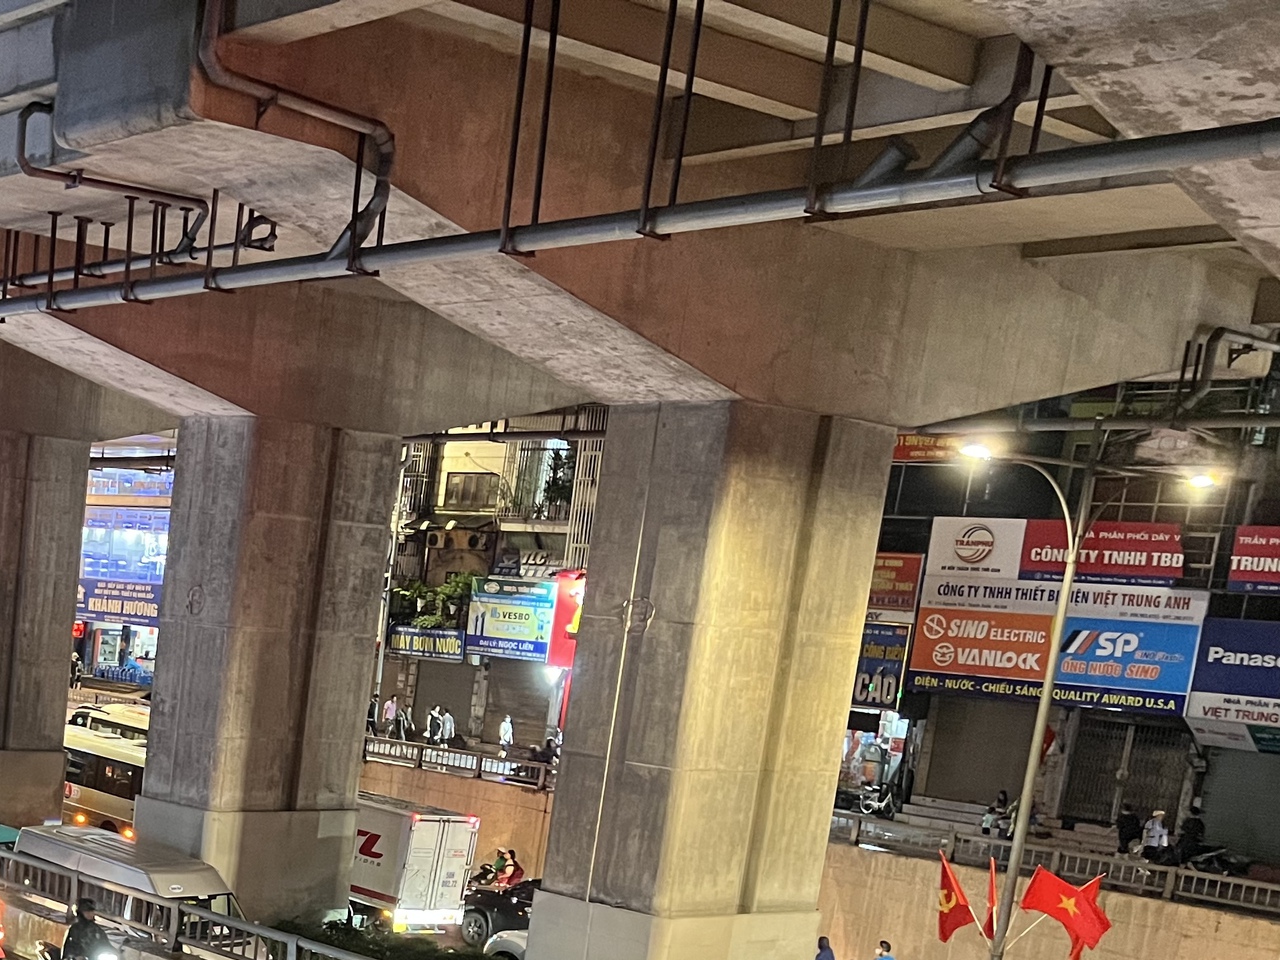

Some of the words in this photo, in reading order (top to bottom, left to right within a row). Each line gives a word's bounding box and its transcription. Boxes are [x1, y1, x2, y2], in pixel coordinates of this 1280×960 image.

[1151, 532, 1171, 541] DÂY
[1079, 549, 1099, 564] TY
[1103, 550, 1147, 566] TNHH
[1230, 555, 1280, 572] TRUN
[88, 596, 122, 613] KHÁNH
[122, 600, 159, 617] HƯƠNG
[937, 582, 964, 598] CÔNG
[967, 586, 980, 598] TY
[983, 586, 1012, 599] TNHH
[1015, 584, 1046, 601] THIẾT
[1092, 591, 1118, 607] VIỆT
[1121, 593, 1161, 609] TRUNG
[1164, 596, 1191, 611] ANH
[502, 611, 530, 621] VESBO
[391, 631, 412, 650] MÁY
[412, 635, 434, 651] BƠM
[436, 636, 462, 655] NƯỚC
[947, 619, 989, 639] SINO
[990, 628, 1046, 644] ELECTRIC
[498, 640, 518, 650] NGỌC
[1095, 631, 1139, 658] SP
[957, 647, 1041, 671] VANLOCK
[1061, 655, 1086, 674] ỐNG
[1124, 662, 1161, 680] SINO
[854, 666, 896, 705] CÁO
[914, 676, 938, 689] ĐIỆN
[945, 678, 975, 691] NƯỚC
[982, 681, 1013, 694] CHIẾU
[1052, 689, 1100, 703] QUALITY
[1101, 694, 1144, 707] AWARD
[1145, 696, 1176, 710] U.S.A
[1202, 705, 1231, 720] VIỆT
[1235, 709, 1279, 723] TRUNG
